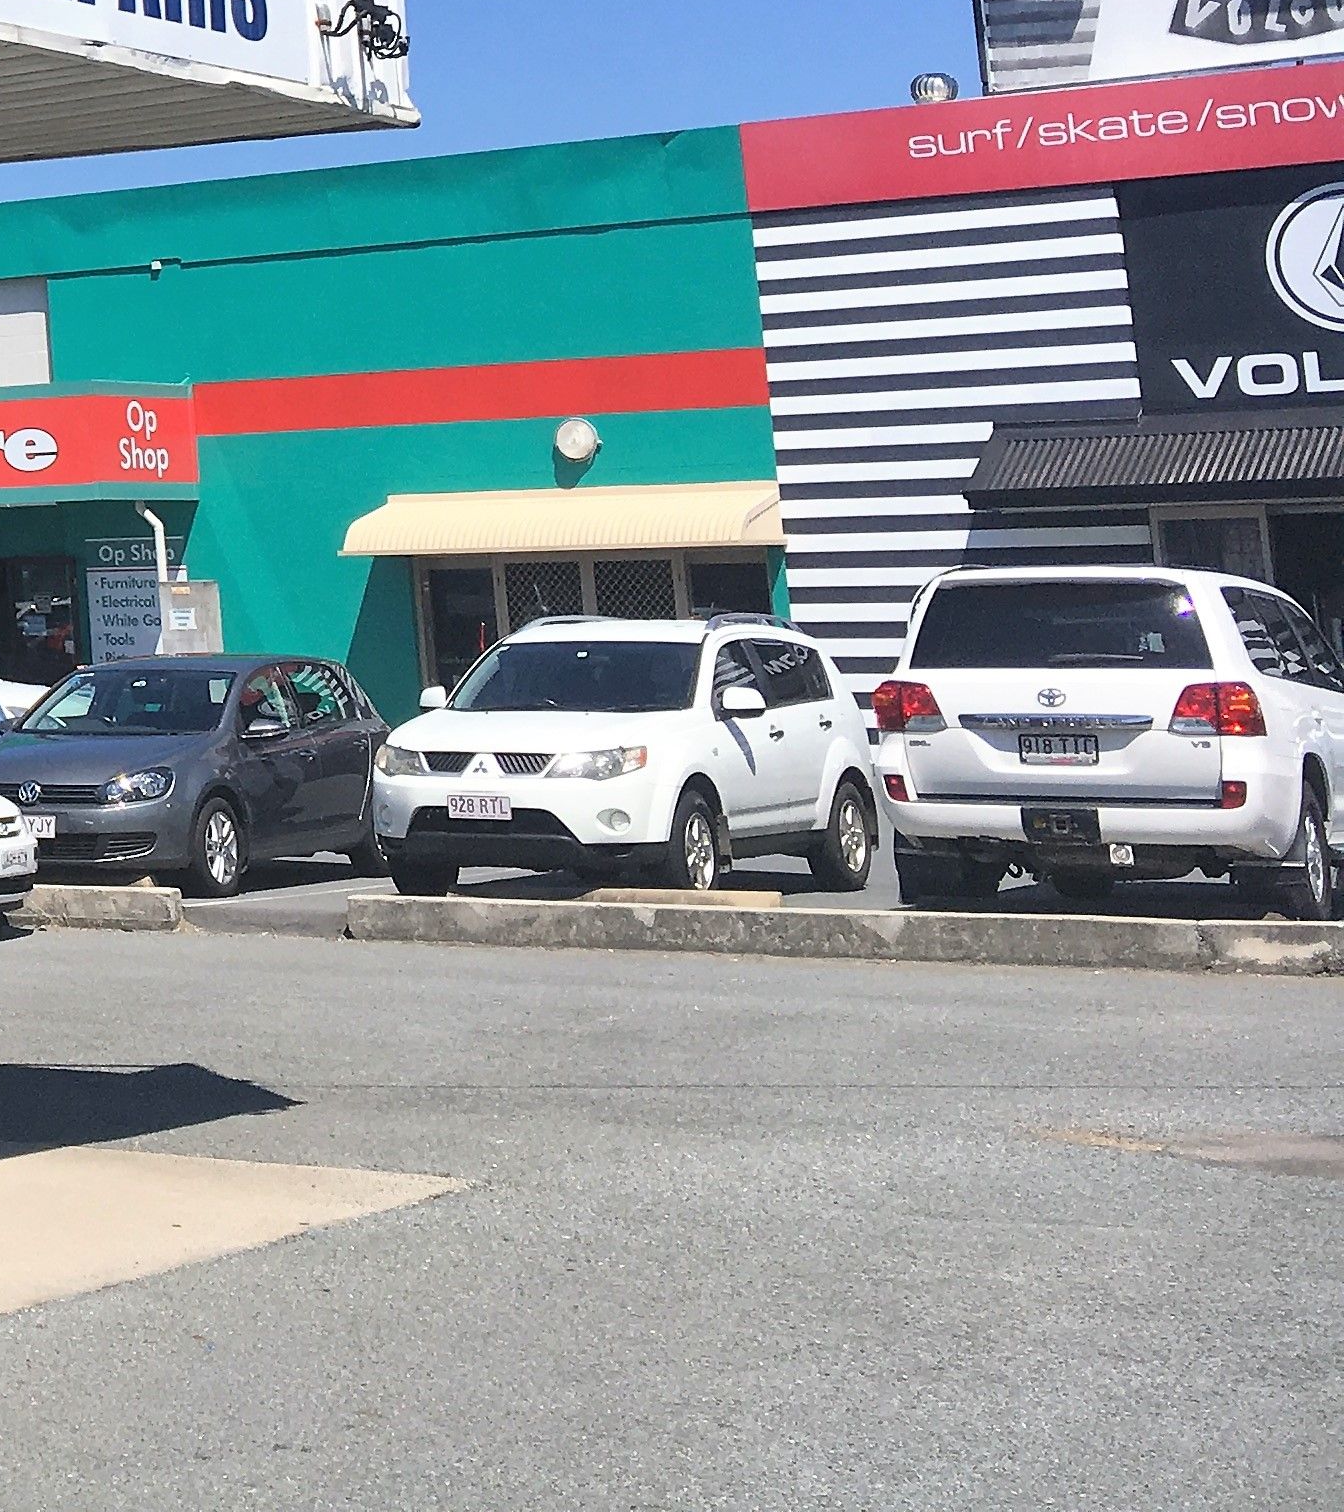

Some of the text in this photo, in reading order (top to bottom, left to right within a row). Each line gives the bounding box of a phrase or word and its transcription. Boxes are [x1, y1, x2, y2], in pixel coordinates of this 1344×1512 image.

[126, 400, 157, 440] Op
[118, 436, 169, 478] Shop
[98, 545, 125, 566] Op
[100, 576, 156, 589] Furniture
[101, 595, 156, 608] Electrical
[102, 614, 139, 627] White
[103, 632, 136, 646] Tools
[450, 797, 509, 815] 928 RTL
